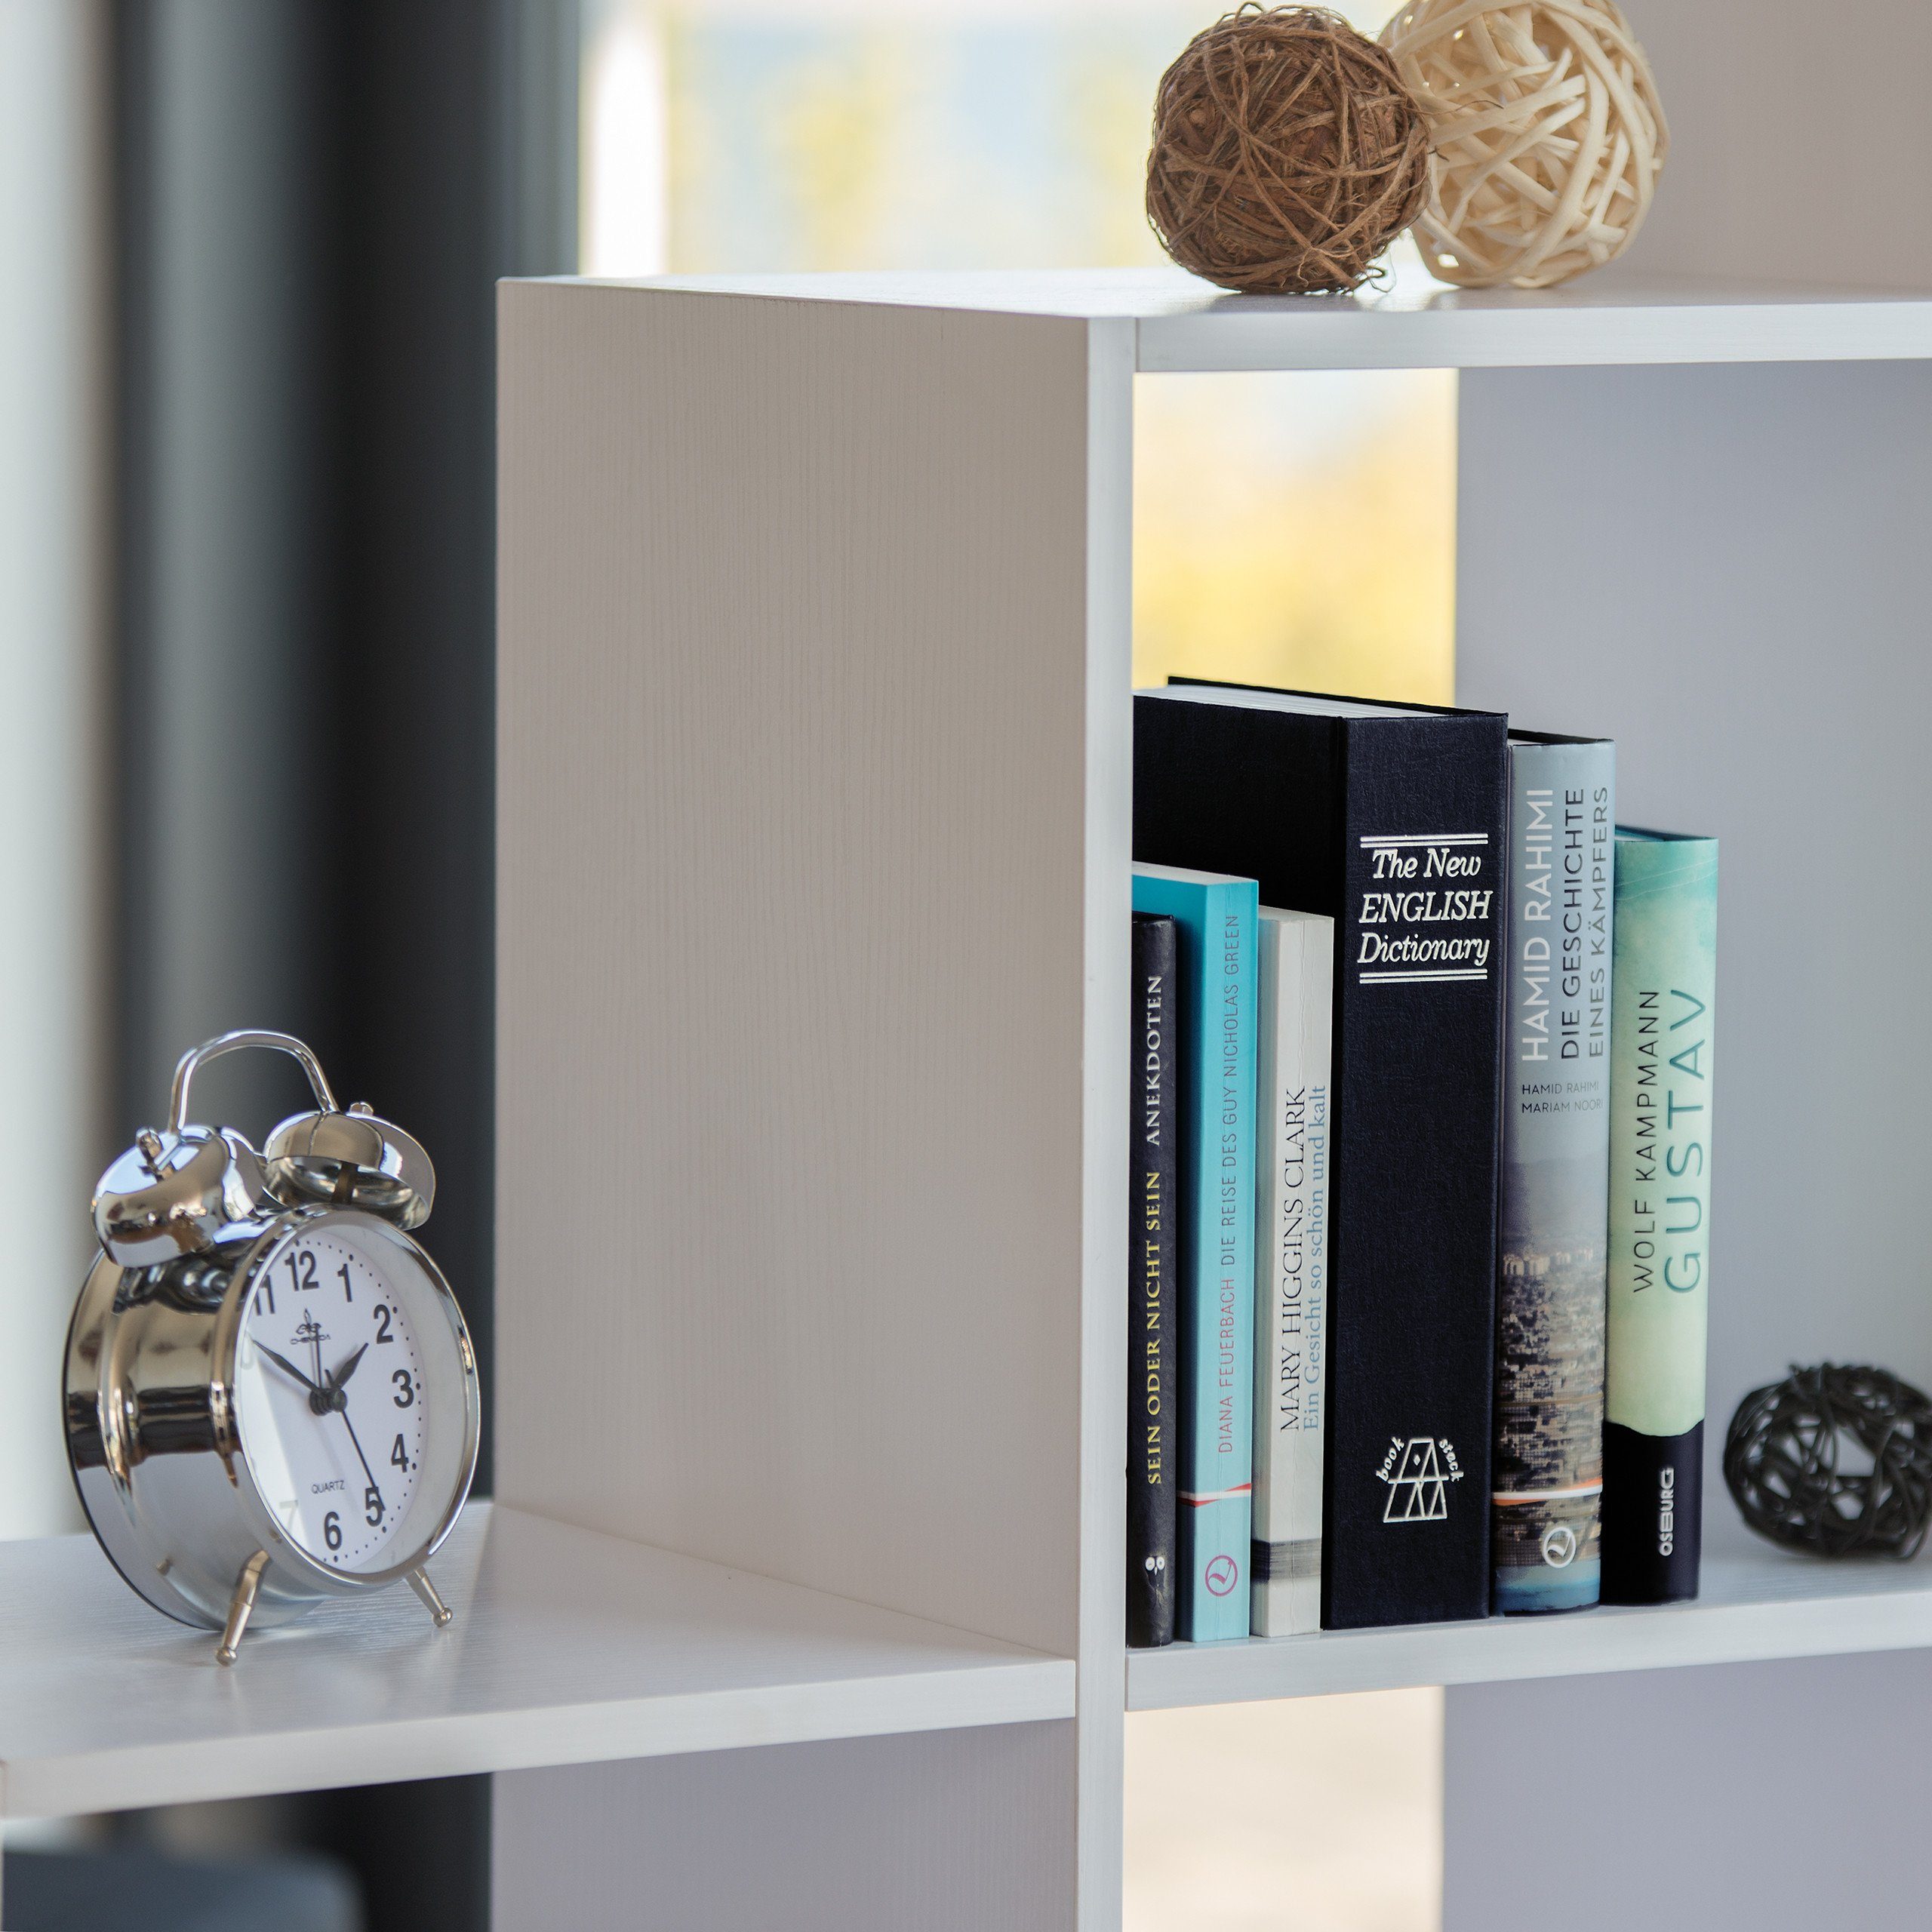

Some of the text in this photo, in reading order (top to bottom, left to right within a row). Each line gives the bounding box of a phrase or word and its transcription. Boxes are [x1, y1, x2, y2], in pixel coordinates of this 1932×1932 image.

[1373, 848, 1481, 878] The New
[1359, 890, 1494, 924] ENGLISH
[1522, 789, 1553, 1060] HAMID RAHIMI
[1561, 789, 1584, 1060] DIE GESCHICHTE
[1588, 786, 1608, 1057] EINES KÄMPFERS
[1357, 932, 1491, 966] Dictionary
[1220, 915, 1240, 1266] DIE REISE DES GUY NICHOLAS GREEN
[1521, 1102, 1570, 1114] MARIAM
[1522, 1081, 1599, 1094] HAMID RAHIMI
[1633, 991, 1660, 1293] WOLF KAMPMANN
[1664, 989, 1706, 1294] GUSTAV
[1146, 975, 1163, 1484] SEIN ODER NICHT SEIN ANEKDOTEN
[285, 1250, 319, 1291] 12
[1280, 1085, 1306, 1432] MARY HIGGINS CLARK
[1303, 1084, 1326, 1432] Ein Gesicht so schön und kalt
[337, 1263, 352, 1303] 1
[374, 1304, 393, 1345] 2
[1218, 1278, 1235, 1454] DIANA FEUERBACH
[392, 1369, 414, 1409] 3
[391, 1433, 409, 1473] 4
[1376, 1436, 1404, 1481] book
[311, 1480, 345, 1494] QUARTZ
[365, 1486, 383, 1527] 5
[324, 1511, 343, 1551] 6
[1659, 1466, 1674, 1556] OSBURG
